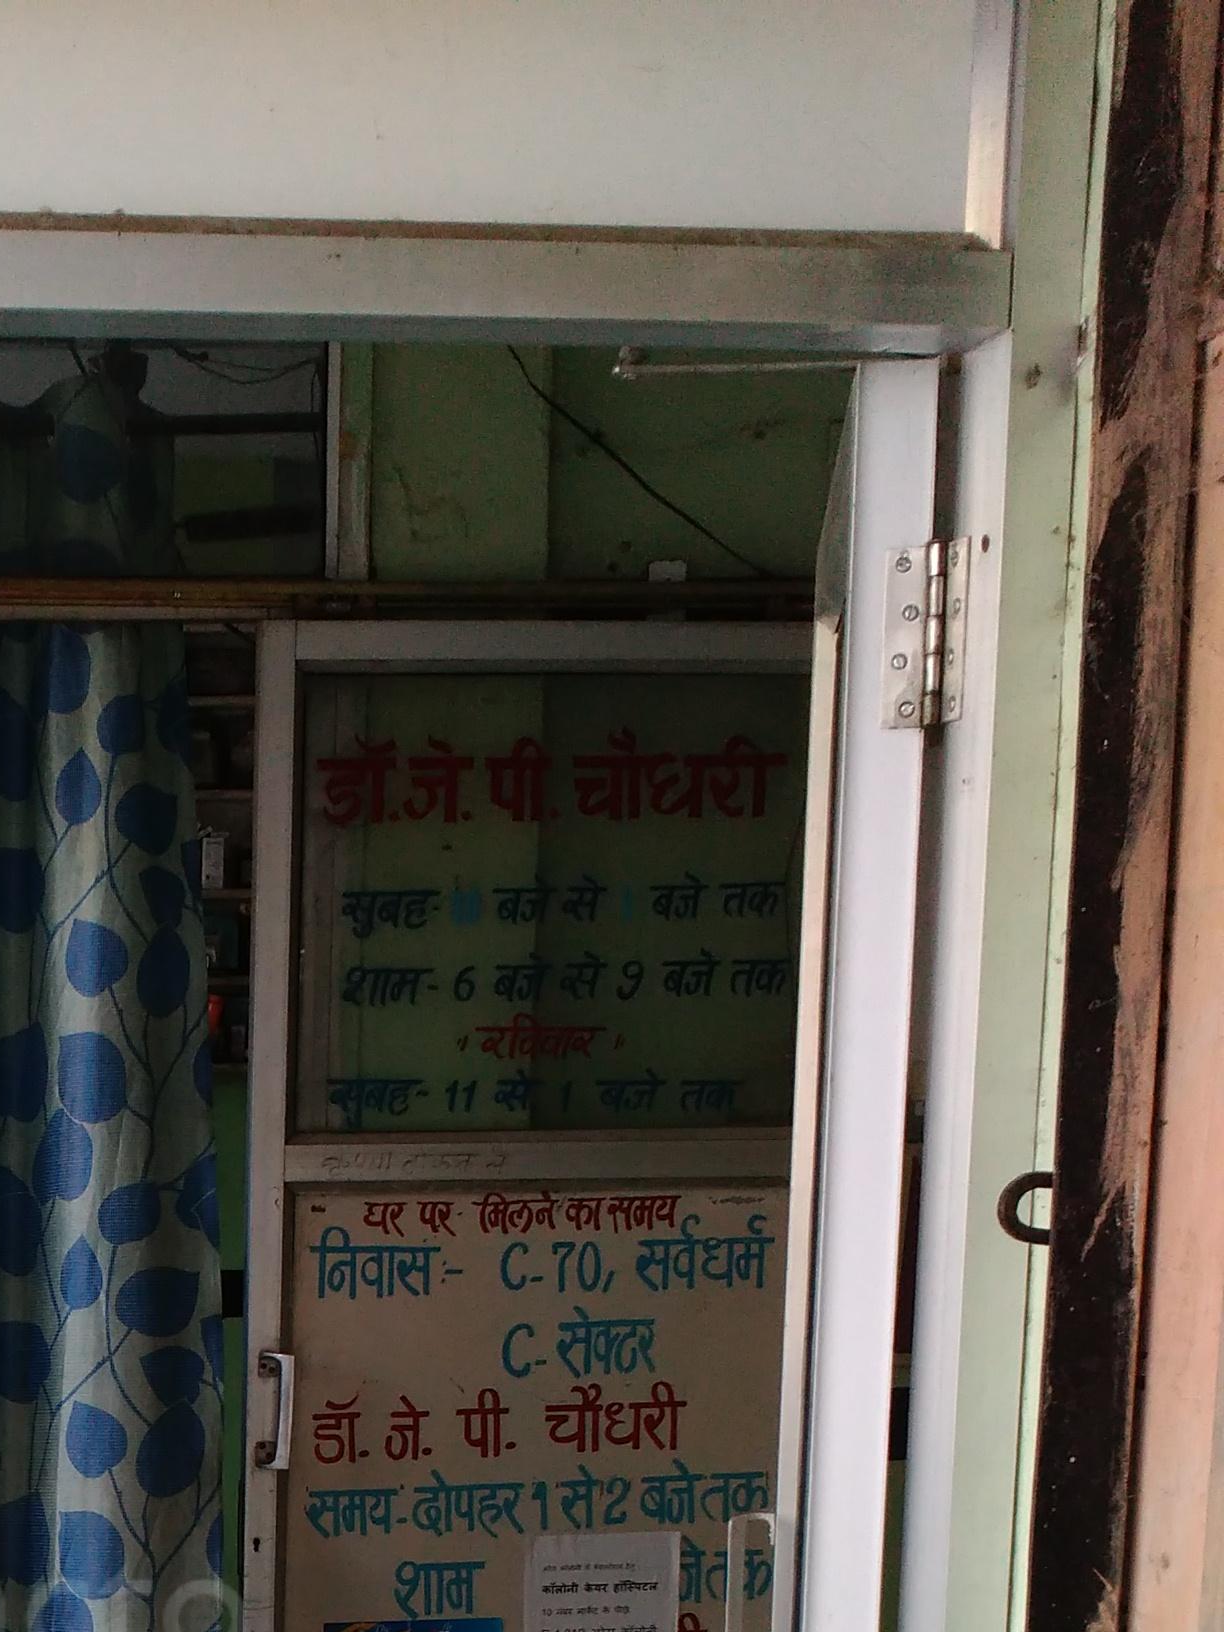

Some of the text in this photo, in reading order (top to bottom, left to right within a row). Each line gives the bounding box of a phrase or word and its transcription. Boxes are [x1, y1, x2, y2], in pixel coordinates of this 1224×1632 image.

[573, 725, 787, 822] चौधरी
[493, 873, 557, 926] बजे
[561, 874, 607, 924] से
[650, 871, 710, 921] बजे
[720, 880, 786, 918] तक
[453, 964, 476, 1001] 6
[493, 953, 555, 1003] बजे
[559, 950, 609, 1000] से
[615, 959, 644, 1001] 9
[663, 948, 722, 999] बजे
[731, 956, 790, 999] तक
[493, 1070, 544, 1113] से
[596, 1068, 666, 1114] बजे
[679, 1079, 746, 1112] तक
[362, 1201, 404, 1237] घर
[472, 1190, 556, 1236] मिलने
[635, 1213, 774, 1292] सर्वधर्म
[545, 1380, 687, 1456] चौधरी
[561, 1464, 600, 1529] से
[601, 1476, 632, 1527] 2
[393, 1561, 486, 1619] शाम
